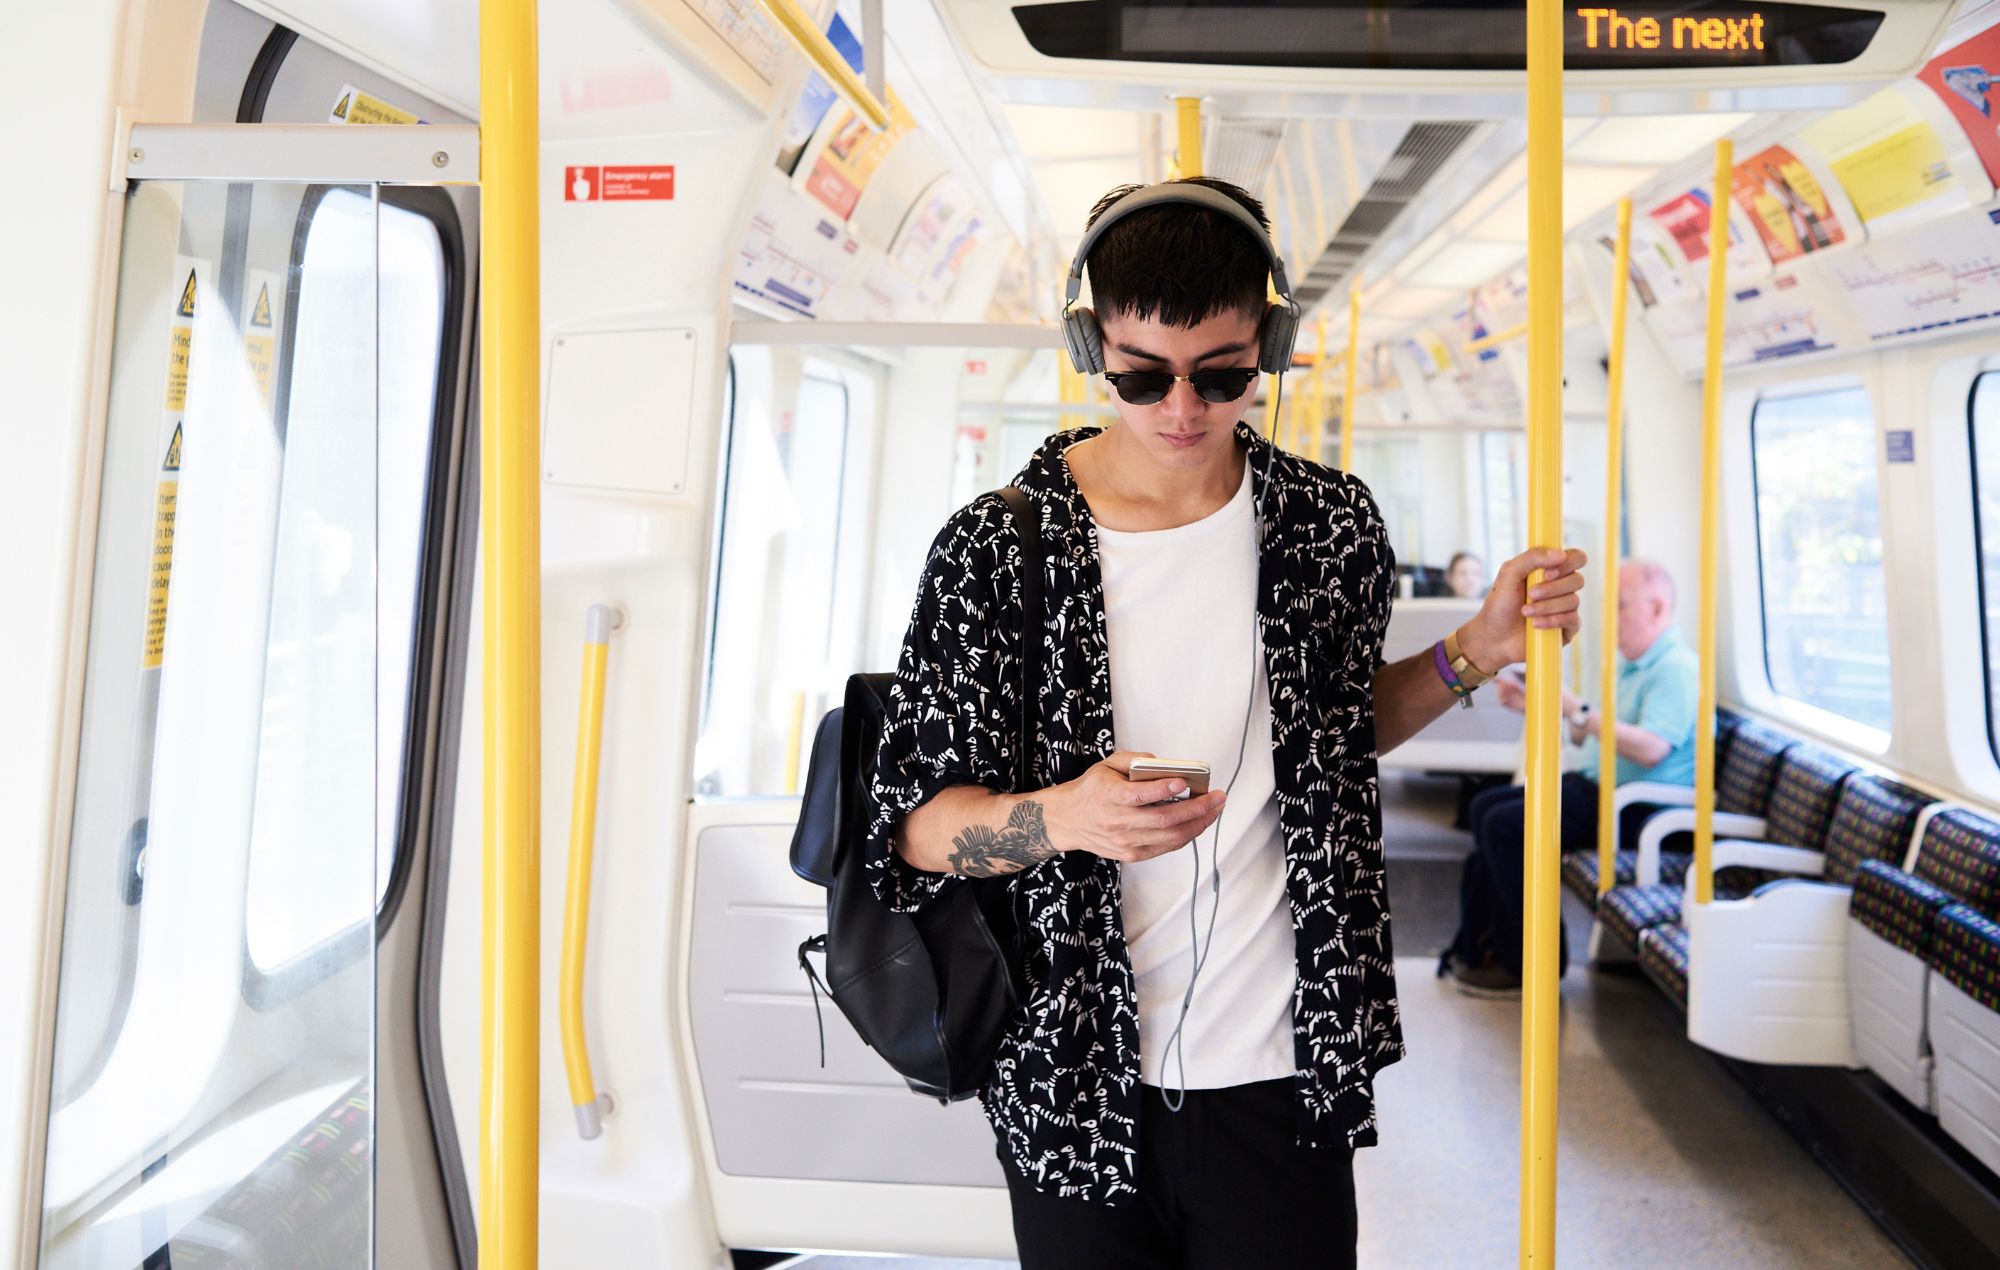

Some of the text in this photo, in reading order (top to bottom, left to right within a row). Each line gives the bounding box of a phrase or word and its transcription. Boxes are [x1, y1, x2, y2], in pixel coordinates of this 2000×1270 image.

[1577, 8, 1765, 50] The next
[604, 171, 648, 182] Emergency
[173, 333, 192, 348] Mind
[171, 351, 185, 365] the
[157, 511, 176, 525] trapp
